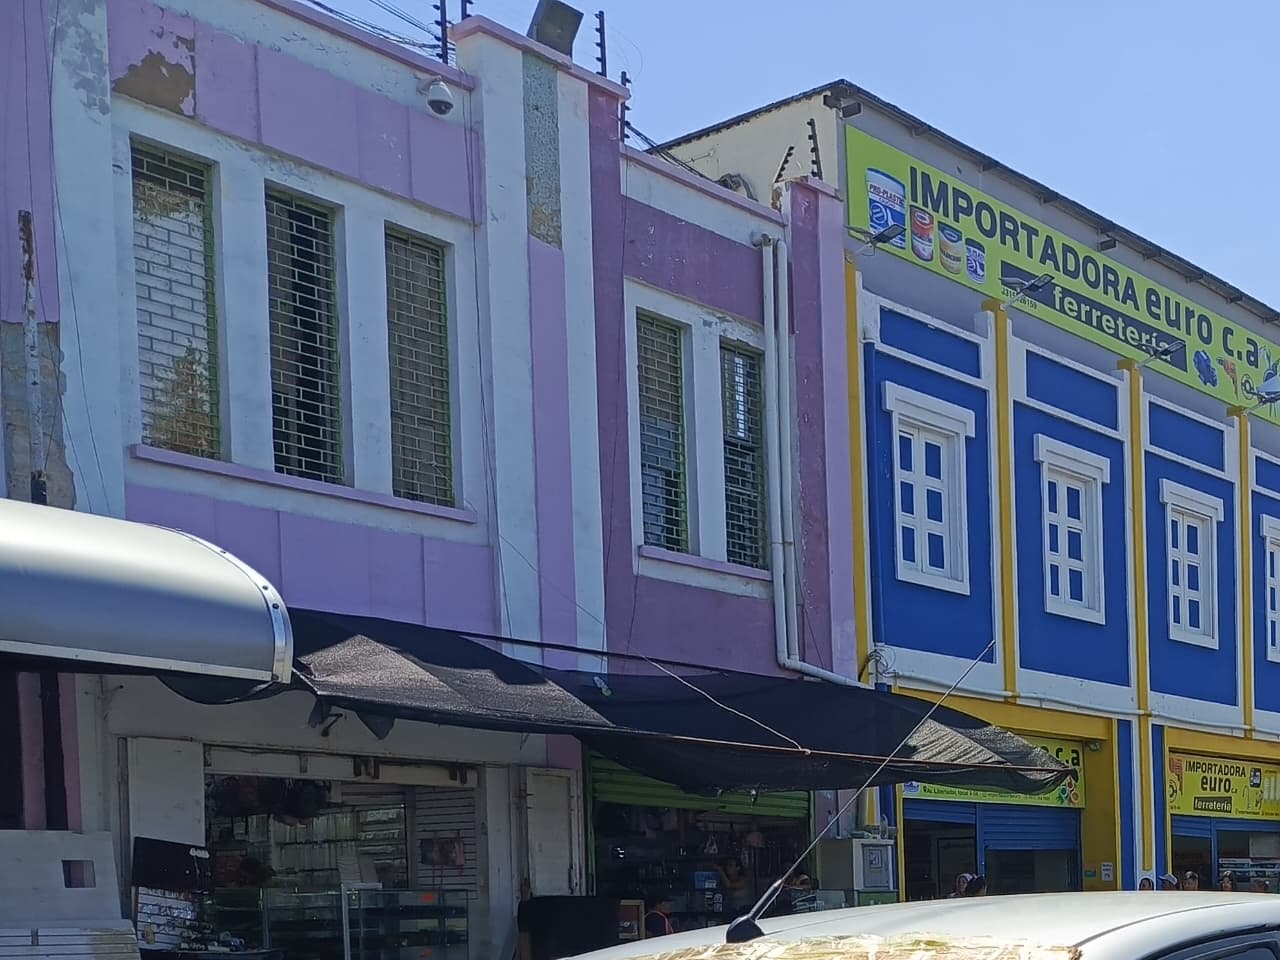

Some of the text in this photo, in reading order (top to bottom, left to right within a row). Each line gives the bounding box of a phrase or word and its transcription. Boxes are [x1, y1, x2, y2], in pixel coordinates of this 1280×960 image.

[910, 166, 1139, 312] IMPORTADORA
[1146, 287, 1213, 347] euro
[1185, 760, 1246, 777] IMPORTADORA
[1201, 776, 1231, 793] euro
